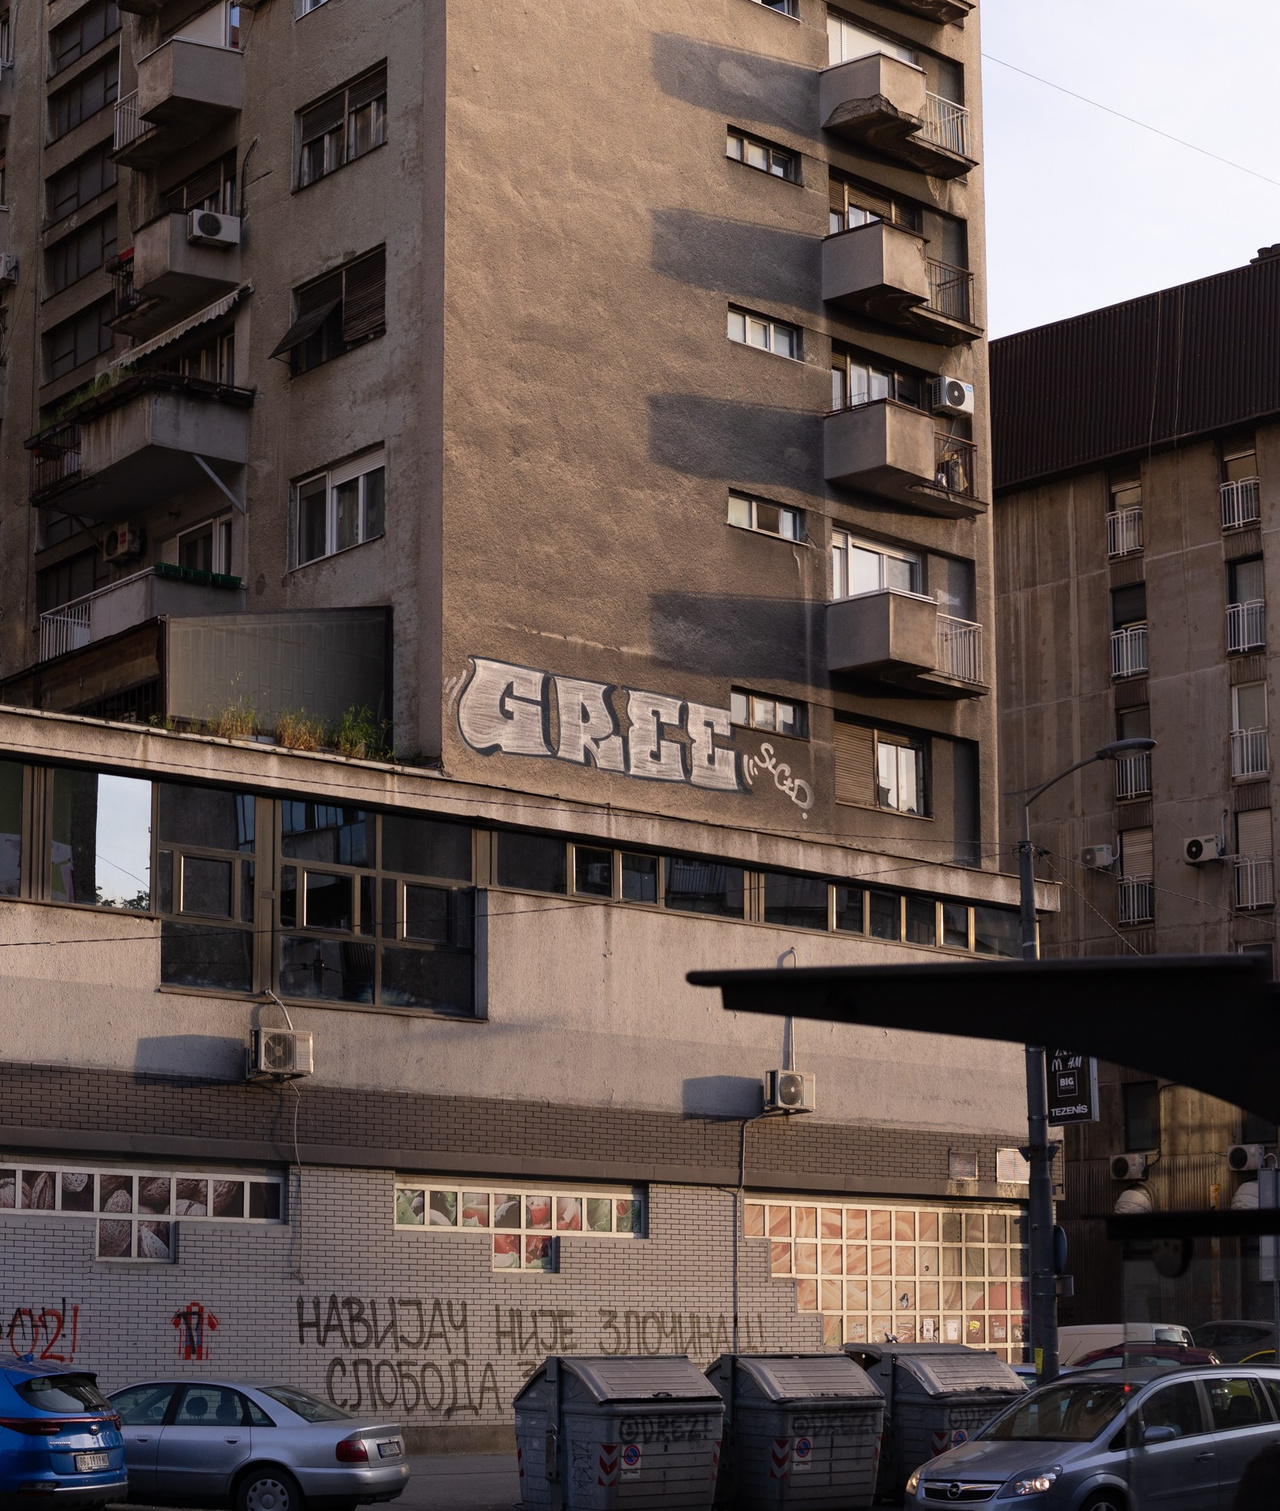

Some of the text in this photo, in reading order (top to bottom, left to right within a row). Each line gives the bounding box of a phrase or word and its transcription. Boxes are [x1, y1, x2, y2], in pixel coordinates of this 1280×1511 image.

[1060, 1077, 1074, 1086] BIG
[296, 1293, 469, 1356] НАВИЈАЧ
[494, 1304, 579, 1356] НИЈЕ
[326, 1356, 505, 1420] СЛОБОДА
